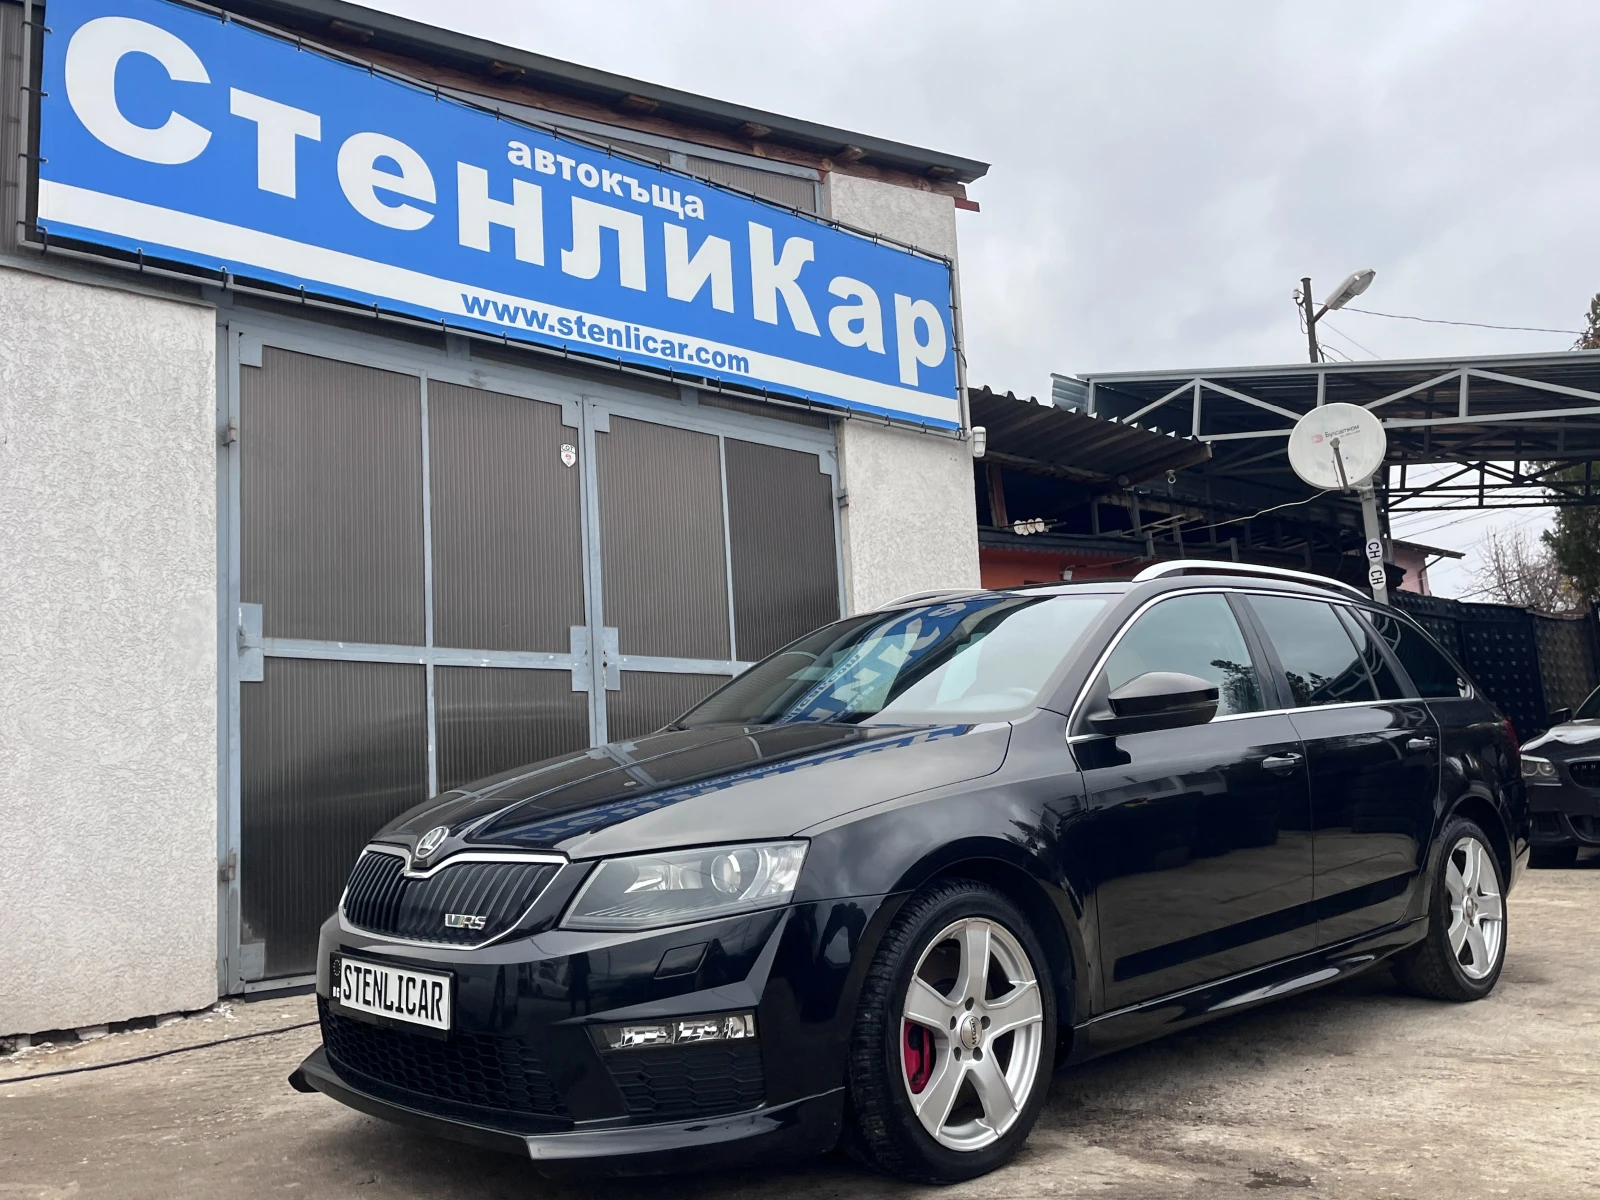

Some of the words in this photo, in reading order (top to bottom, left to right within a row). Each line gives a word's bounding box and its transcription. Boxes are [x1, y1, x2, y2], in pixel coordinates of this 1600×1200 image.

[65, 16, 947, 387] СтенлиКар
[507, 140, 704, 220] автокъща
[461, 293, 750, 374] www.stenlicar.com
[1368, 541, 1381, 559] CH
[1370, 570, 1384, 585] CH
[343, 964, 443, 1022] STENLICAR
